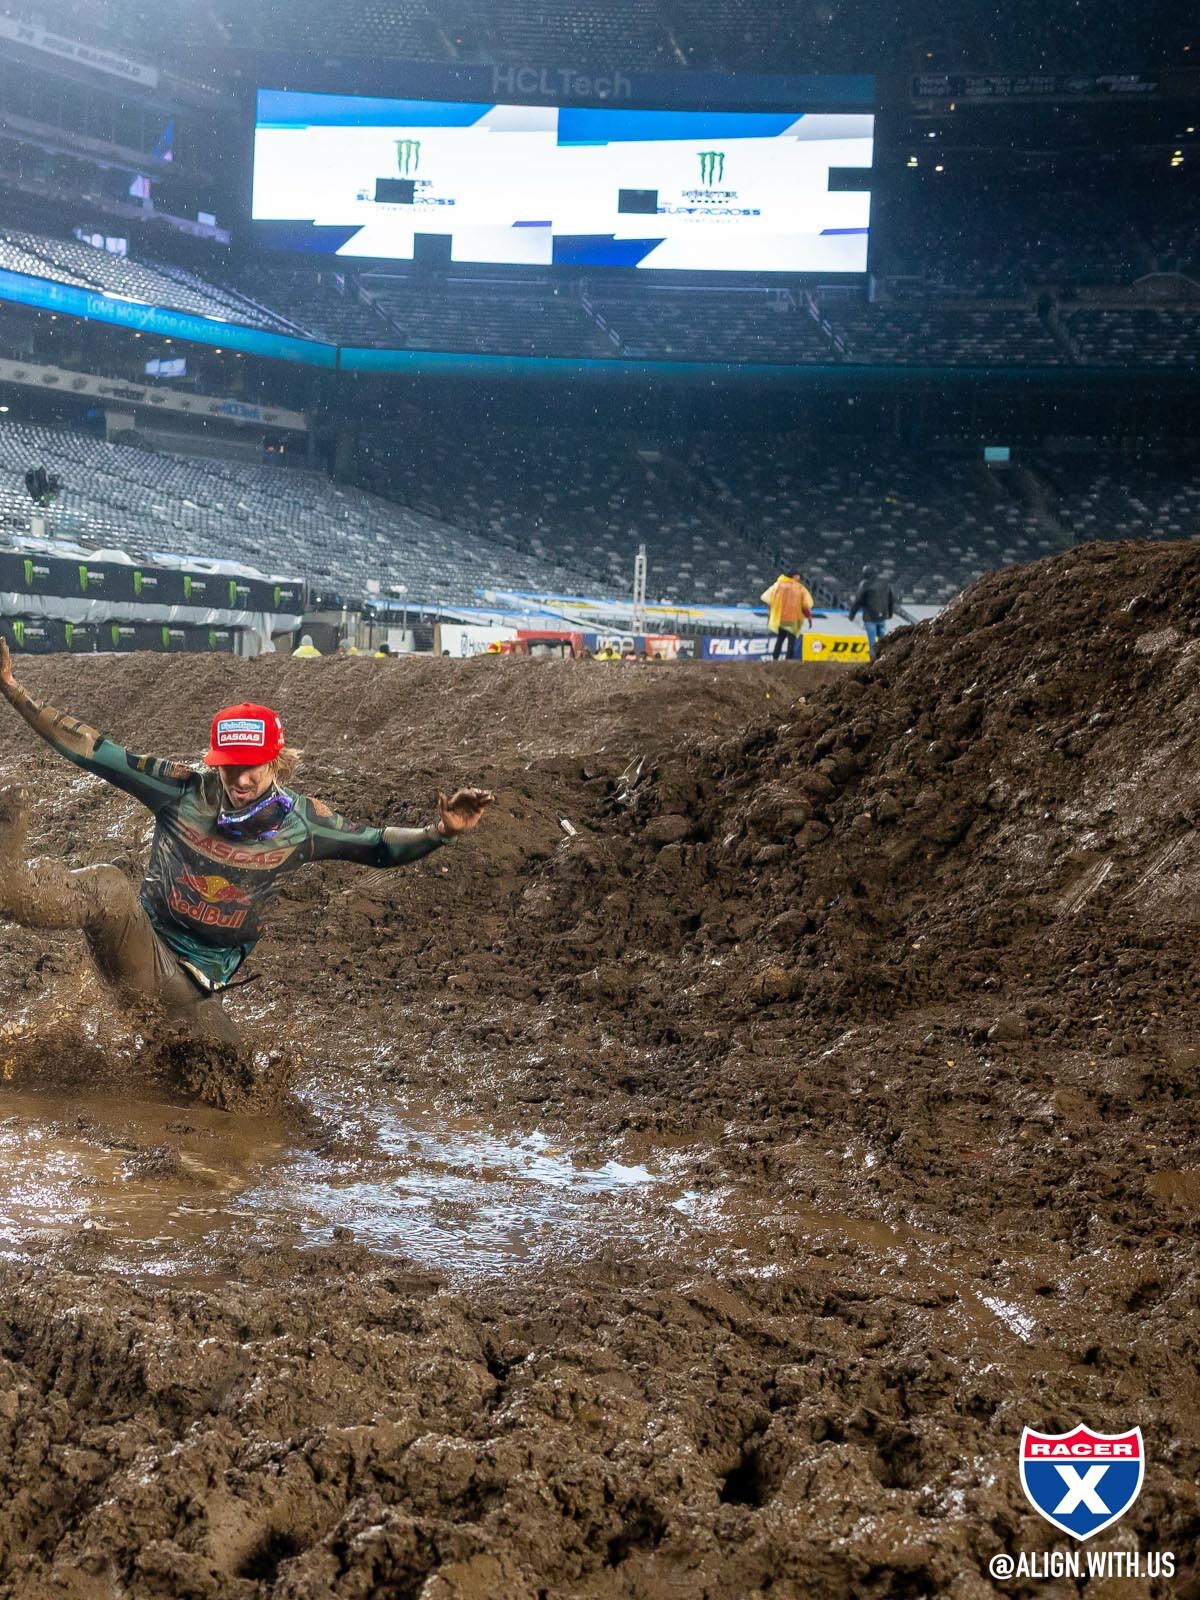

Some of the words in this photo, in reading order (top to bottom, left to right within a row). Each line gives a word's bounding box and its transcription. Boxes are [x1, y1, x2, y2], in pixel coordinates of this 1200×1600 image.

[492, 66, 632, 98] HCLTech
[220, 733, 261, 743] GASGAS
[179, 823, 286, 866] GASGAS
[168, 886, 206, 921] Red
[200, 905, 248, 929] Bull
